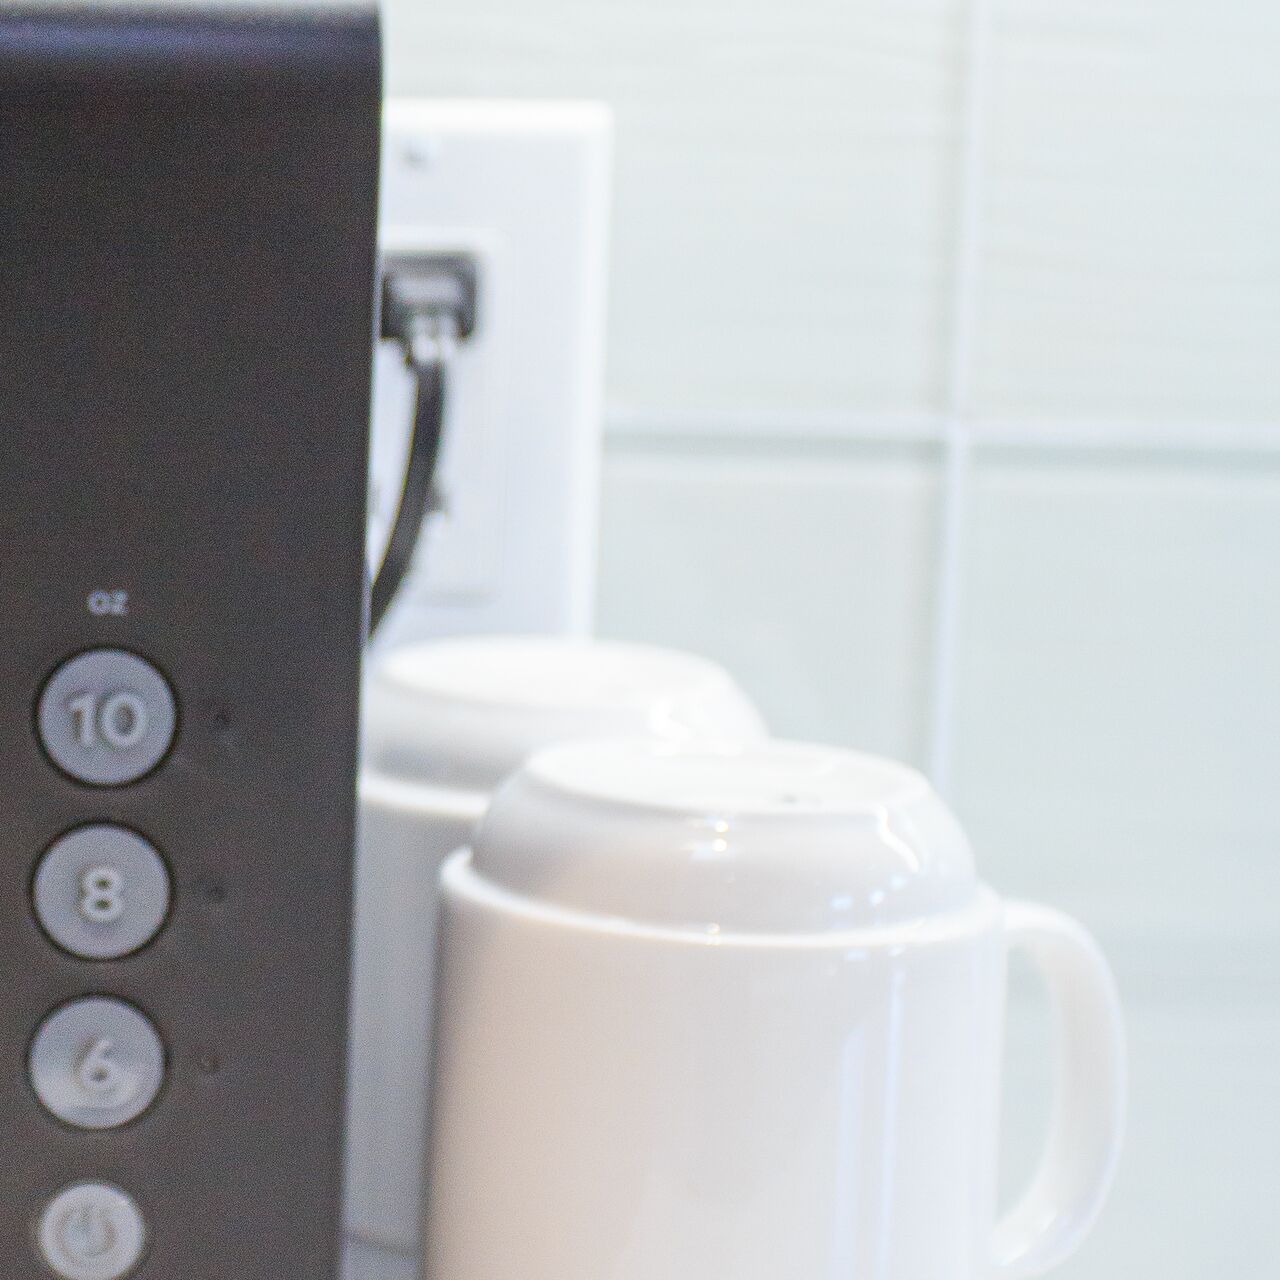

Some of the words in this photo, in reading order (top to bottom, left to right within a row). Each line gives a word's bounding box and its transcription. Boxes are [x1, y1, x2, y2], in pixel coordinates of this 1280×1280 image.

[66, 690, 146, 749] 10
[80, 867, 126, 923] 8
[78, 1038, 123, 1097] 6
